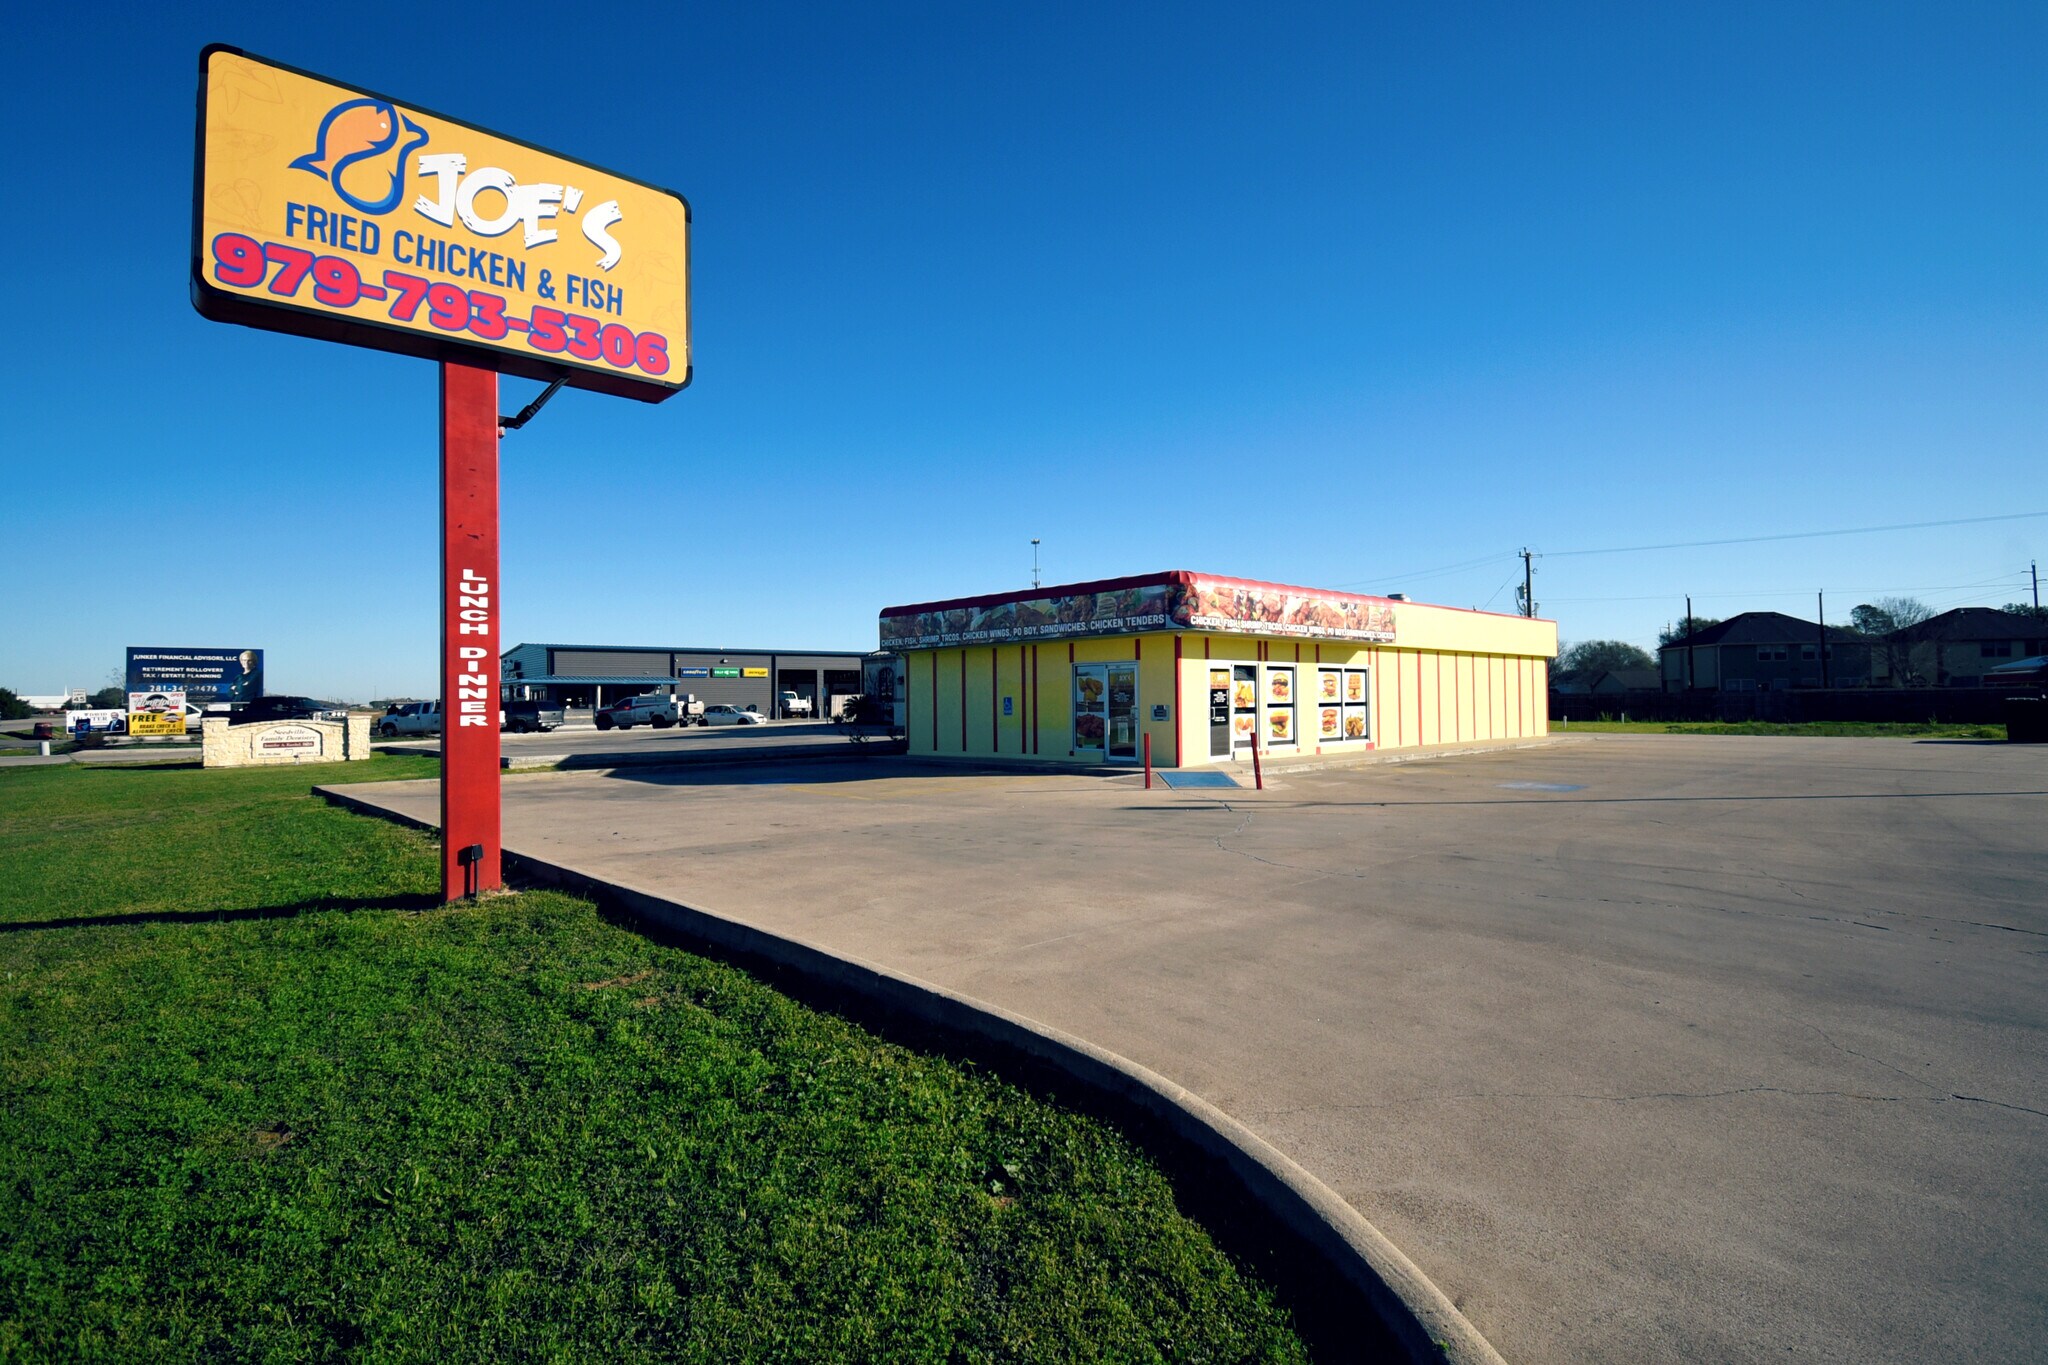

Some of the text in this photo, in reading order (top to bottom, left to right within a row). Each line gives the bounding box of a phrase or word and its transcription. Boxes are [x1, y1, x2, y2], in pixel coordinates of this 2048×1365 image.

[413, 152, 623, 272] JOE'S
[285, 201, 623, 316] FRIED CHICKEN & FISH
[211, 232, 670, 376] 979-793-5306
[459, 568, 489, 636] LUNCH
[962, 630, 988, 640] CHICKEN
[989, 627, 1012, 638] WINGS,
[1013, 625, 1022, 636] PO
[1023, 624, 1039, 635] BOY,
[1040, 621, 1089, 634] SANDWICHES,
[1090, 616, 1123, 630] CHICKEN
[1125, 613, 1165, 627] TENDERS
[131, 714, 158, 723] FREE
[458, 646, 489, 727] DINNER
